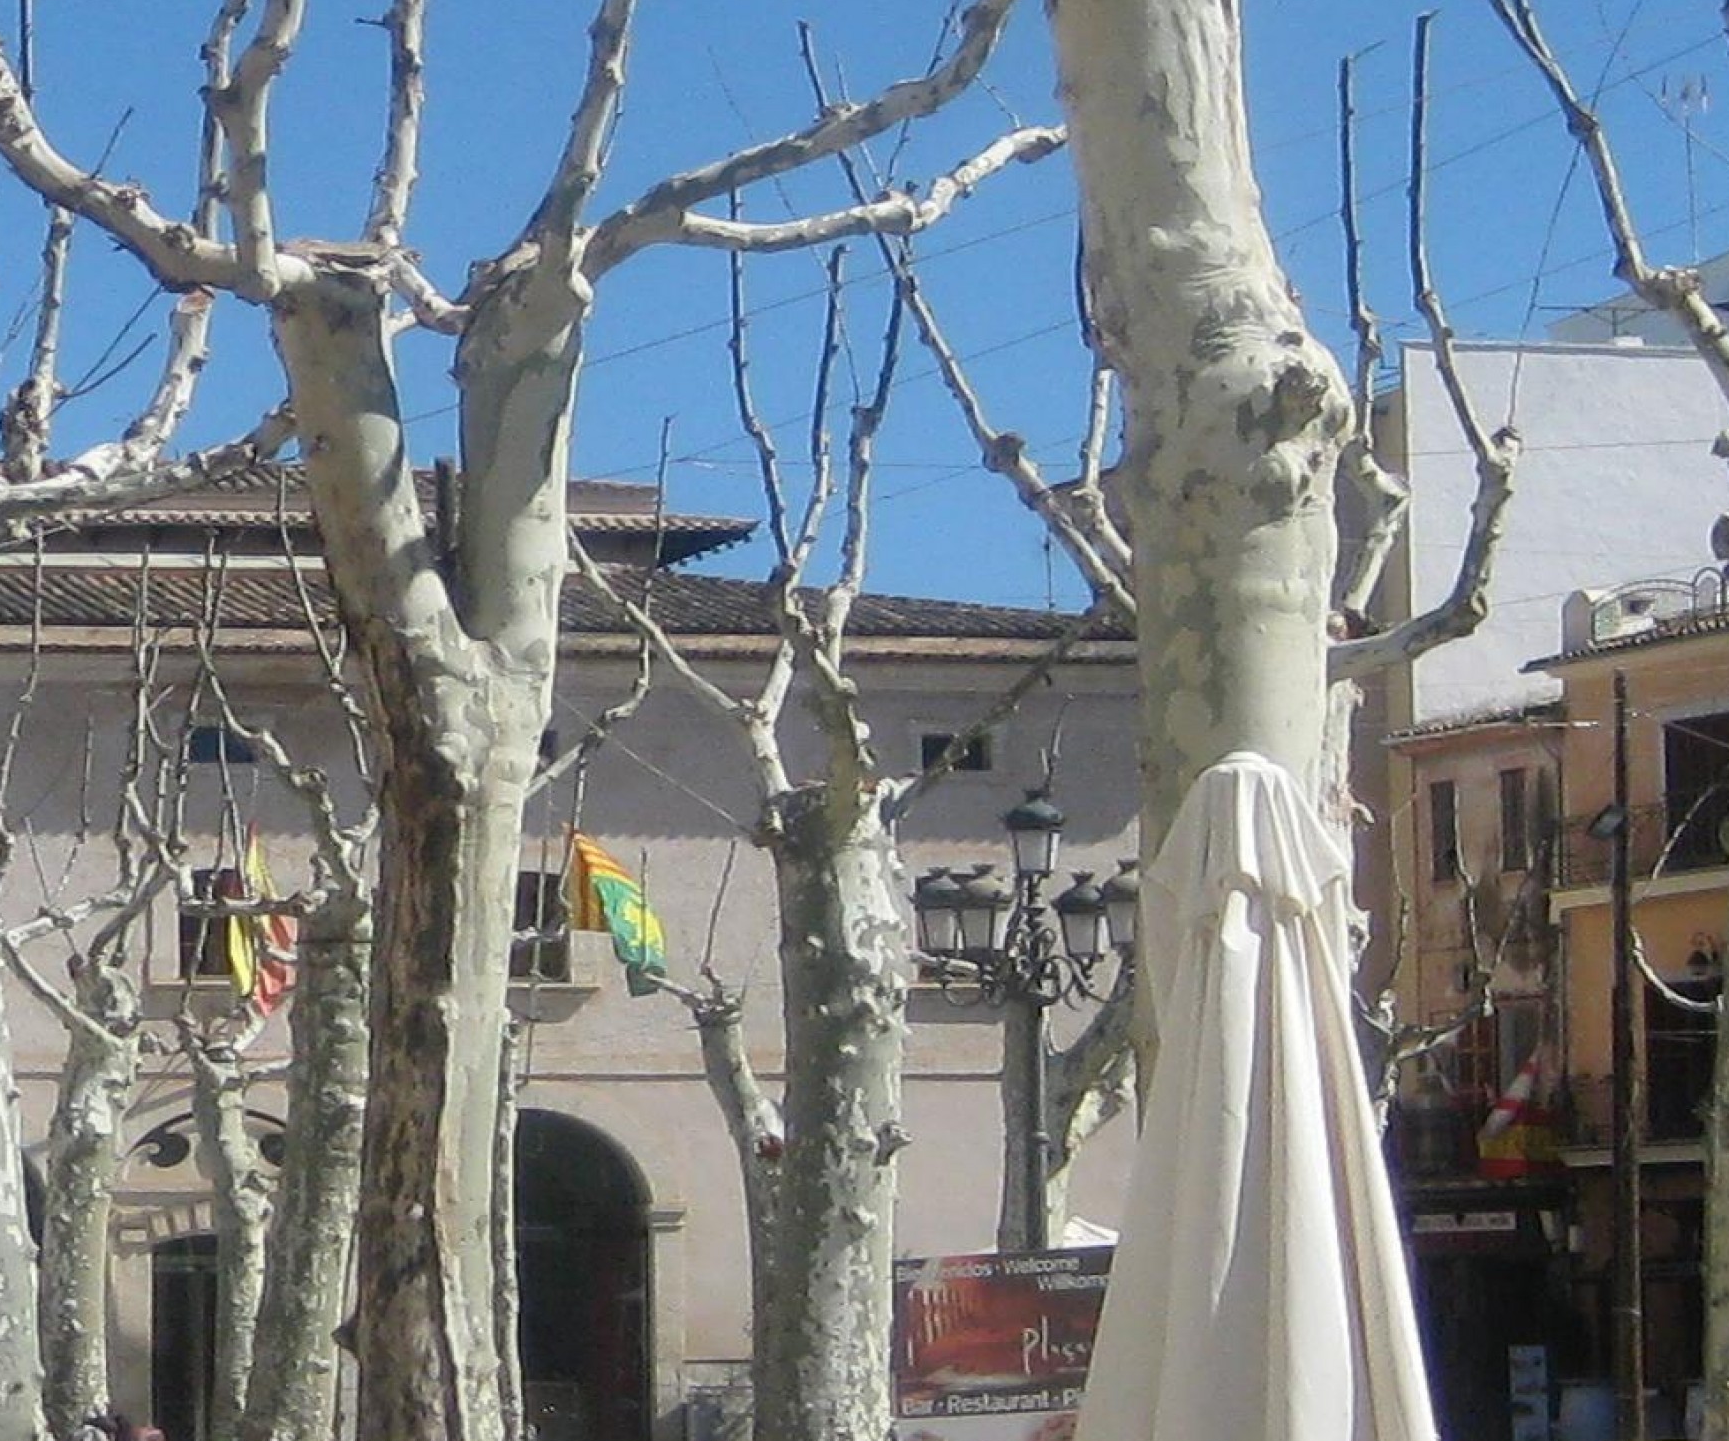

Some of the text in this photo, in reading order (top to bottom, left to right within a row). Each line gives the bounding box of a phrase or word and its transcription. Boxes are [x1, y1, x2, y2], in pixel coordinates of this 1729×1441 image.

[1005, 1257, 1080, 1275] Welcome
[902, 1398, 935, 1416] Bar
[947, 1390, 1050, 1415] Restaurant
